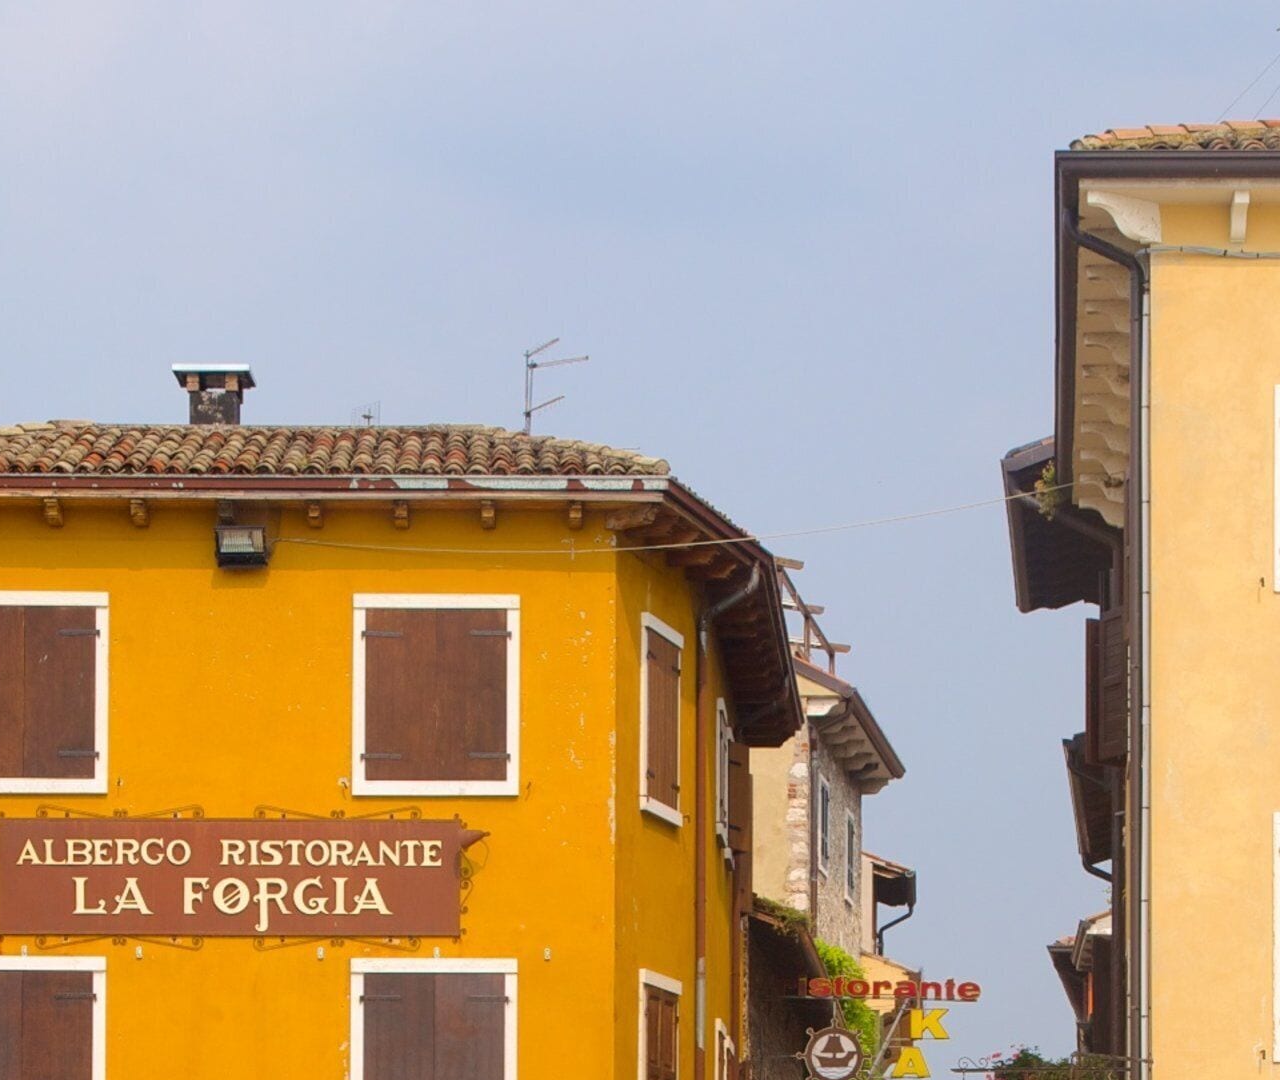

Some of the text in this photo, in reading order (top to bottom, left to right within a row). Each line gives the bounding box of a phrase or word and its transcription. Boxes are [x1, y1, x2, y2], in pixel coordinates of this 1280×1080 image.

[17, 838, 442, 868] ALBERGO RISTORANTE
[72, 876, 393, 932] LA FORGIA
